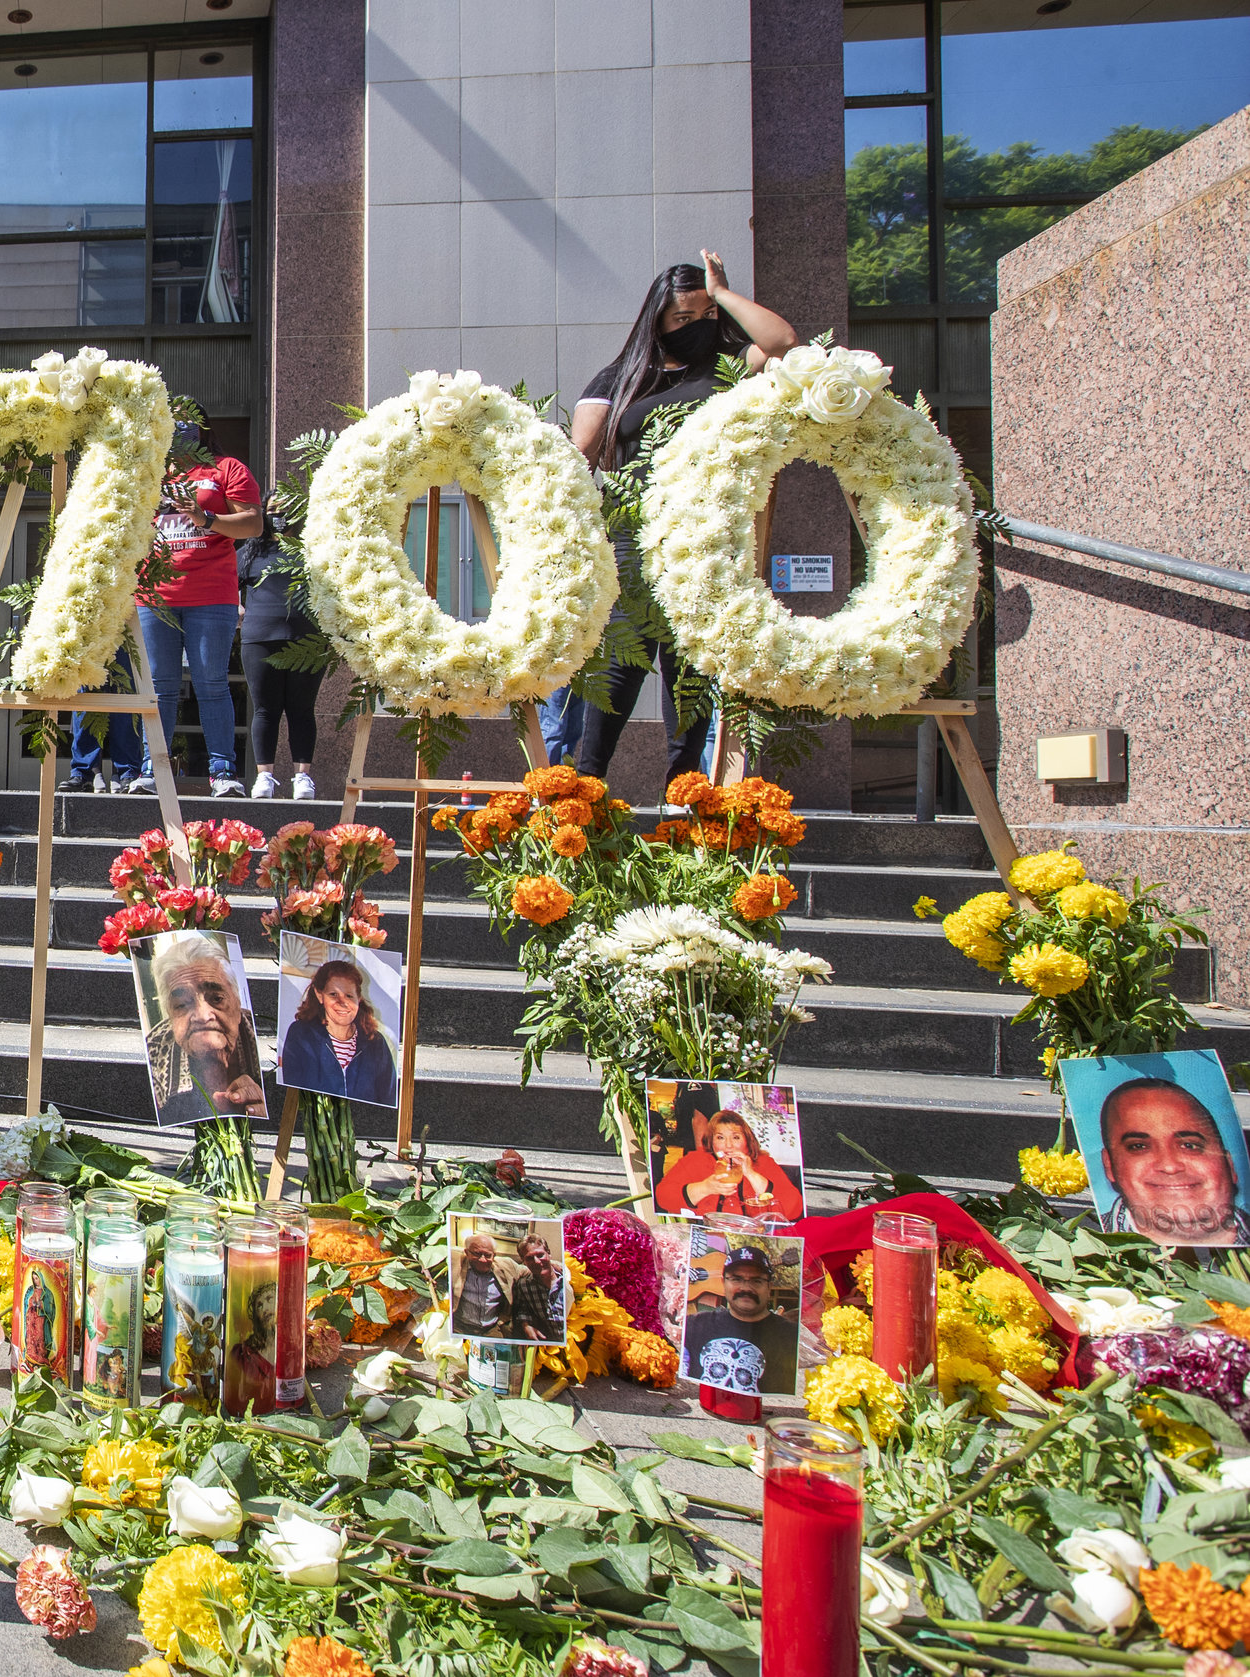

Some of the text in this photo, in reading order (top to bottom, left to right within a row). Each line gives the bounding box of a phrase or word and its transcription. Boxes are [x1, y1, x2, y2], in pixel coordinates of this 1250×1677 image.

[173, 542, 184, 550] LOS
[185, 541, 207, 549] ANGELES
[740, 1248, 753, 1260] LA
